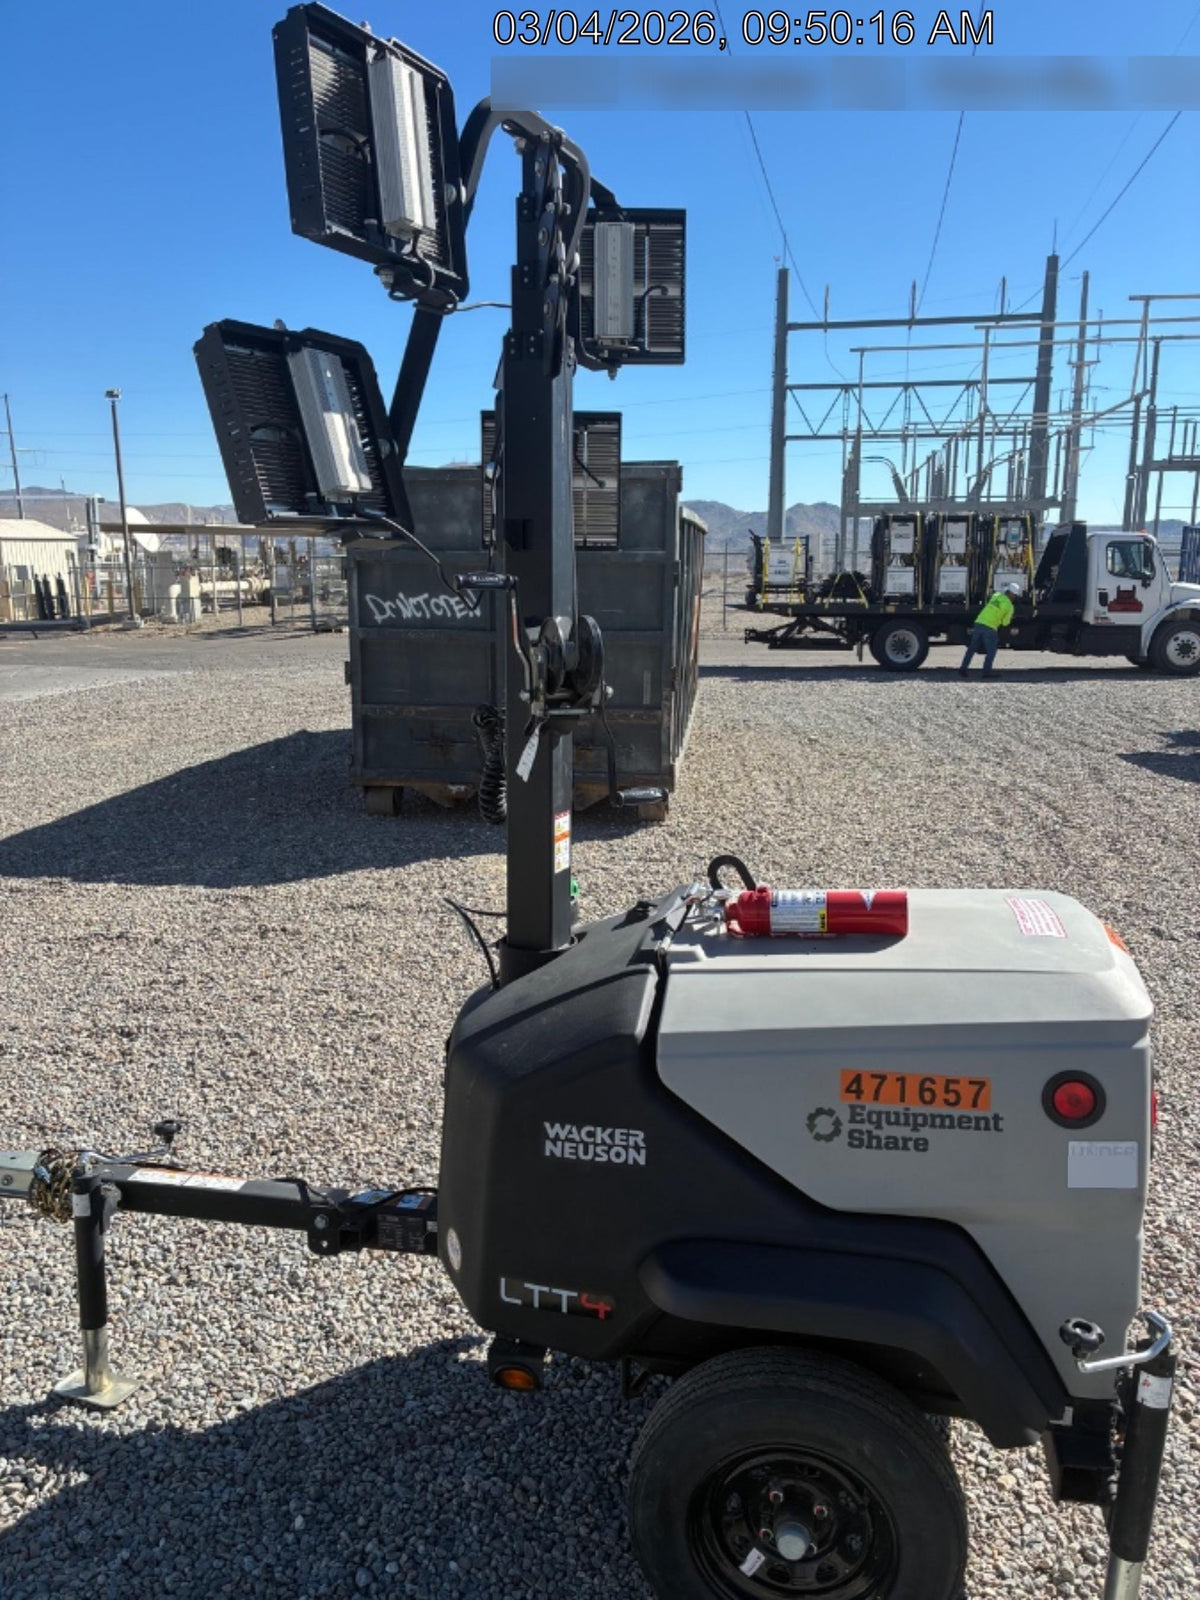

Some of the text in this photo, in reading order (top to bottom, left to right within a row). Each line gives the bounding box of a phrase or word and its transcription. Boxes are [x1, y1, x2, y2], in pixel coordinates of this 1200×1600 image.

[845, 1073, 986, 1108] 471657
[848, 1104, 1004, 1132] Equipment
[543, 1121, 646, 1147] WACKER
[847, 1128, 929, 1152] Share
[544, 1140, 646, 1166] NEUSON
[500, 1277, 612, 1320] LTT4
